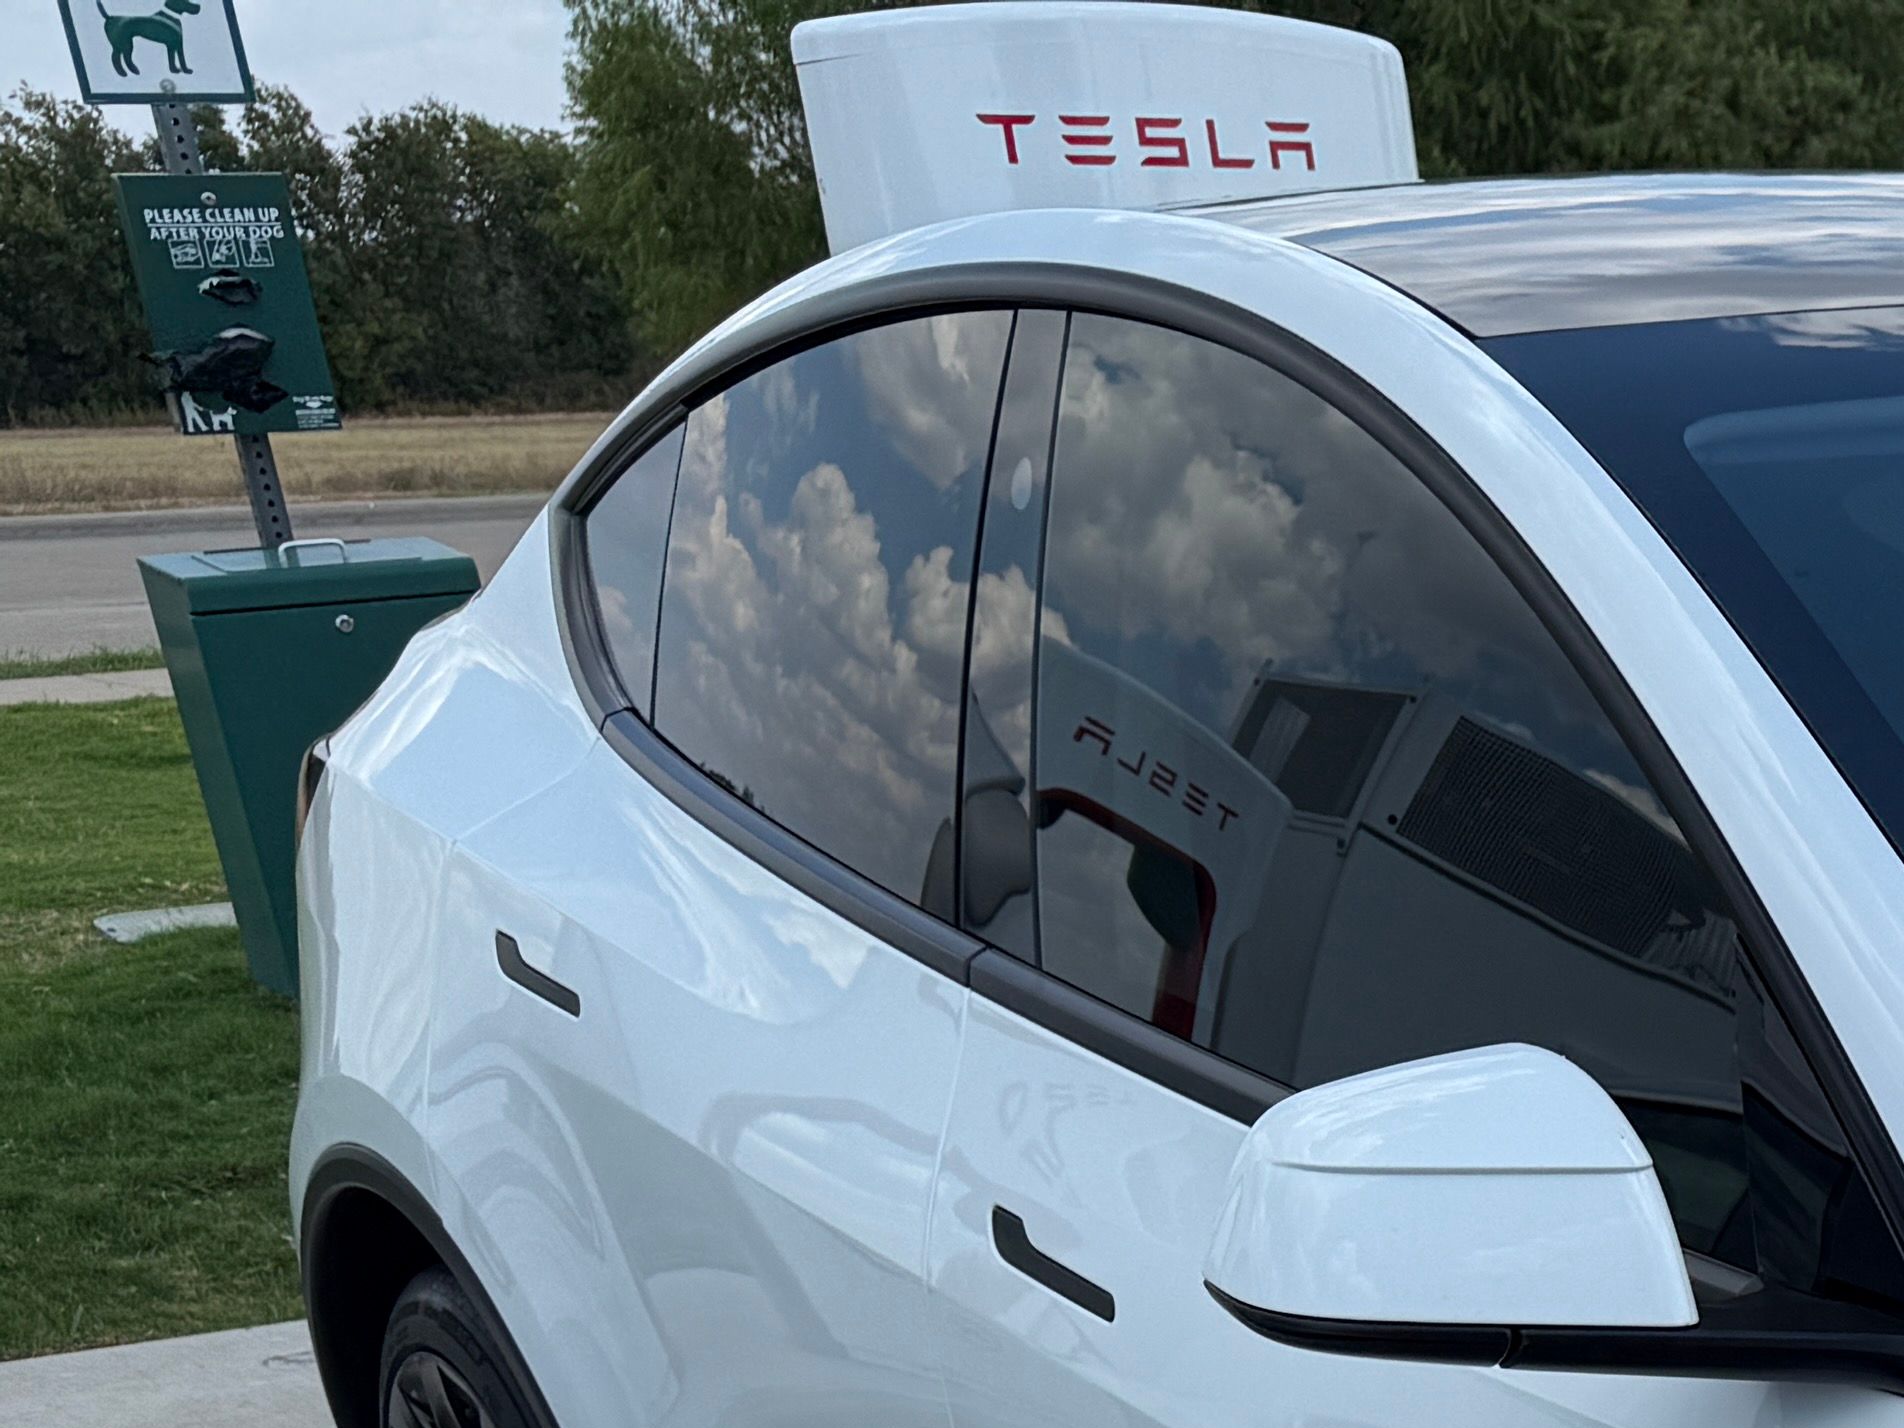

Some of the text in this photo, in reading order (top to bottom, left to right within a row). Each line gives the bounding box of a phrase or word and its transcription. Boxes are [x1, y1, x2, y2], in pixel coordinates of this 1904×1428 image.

[975, 113, 1316, 171] TESLA
[143, 207, 279, 224] PLEASE CLEAN UP
[150, 225, 284, 241] AFTER YOUR DOG
